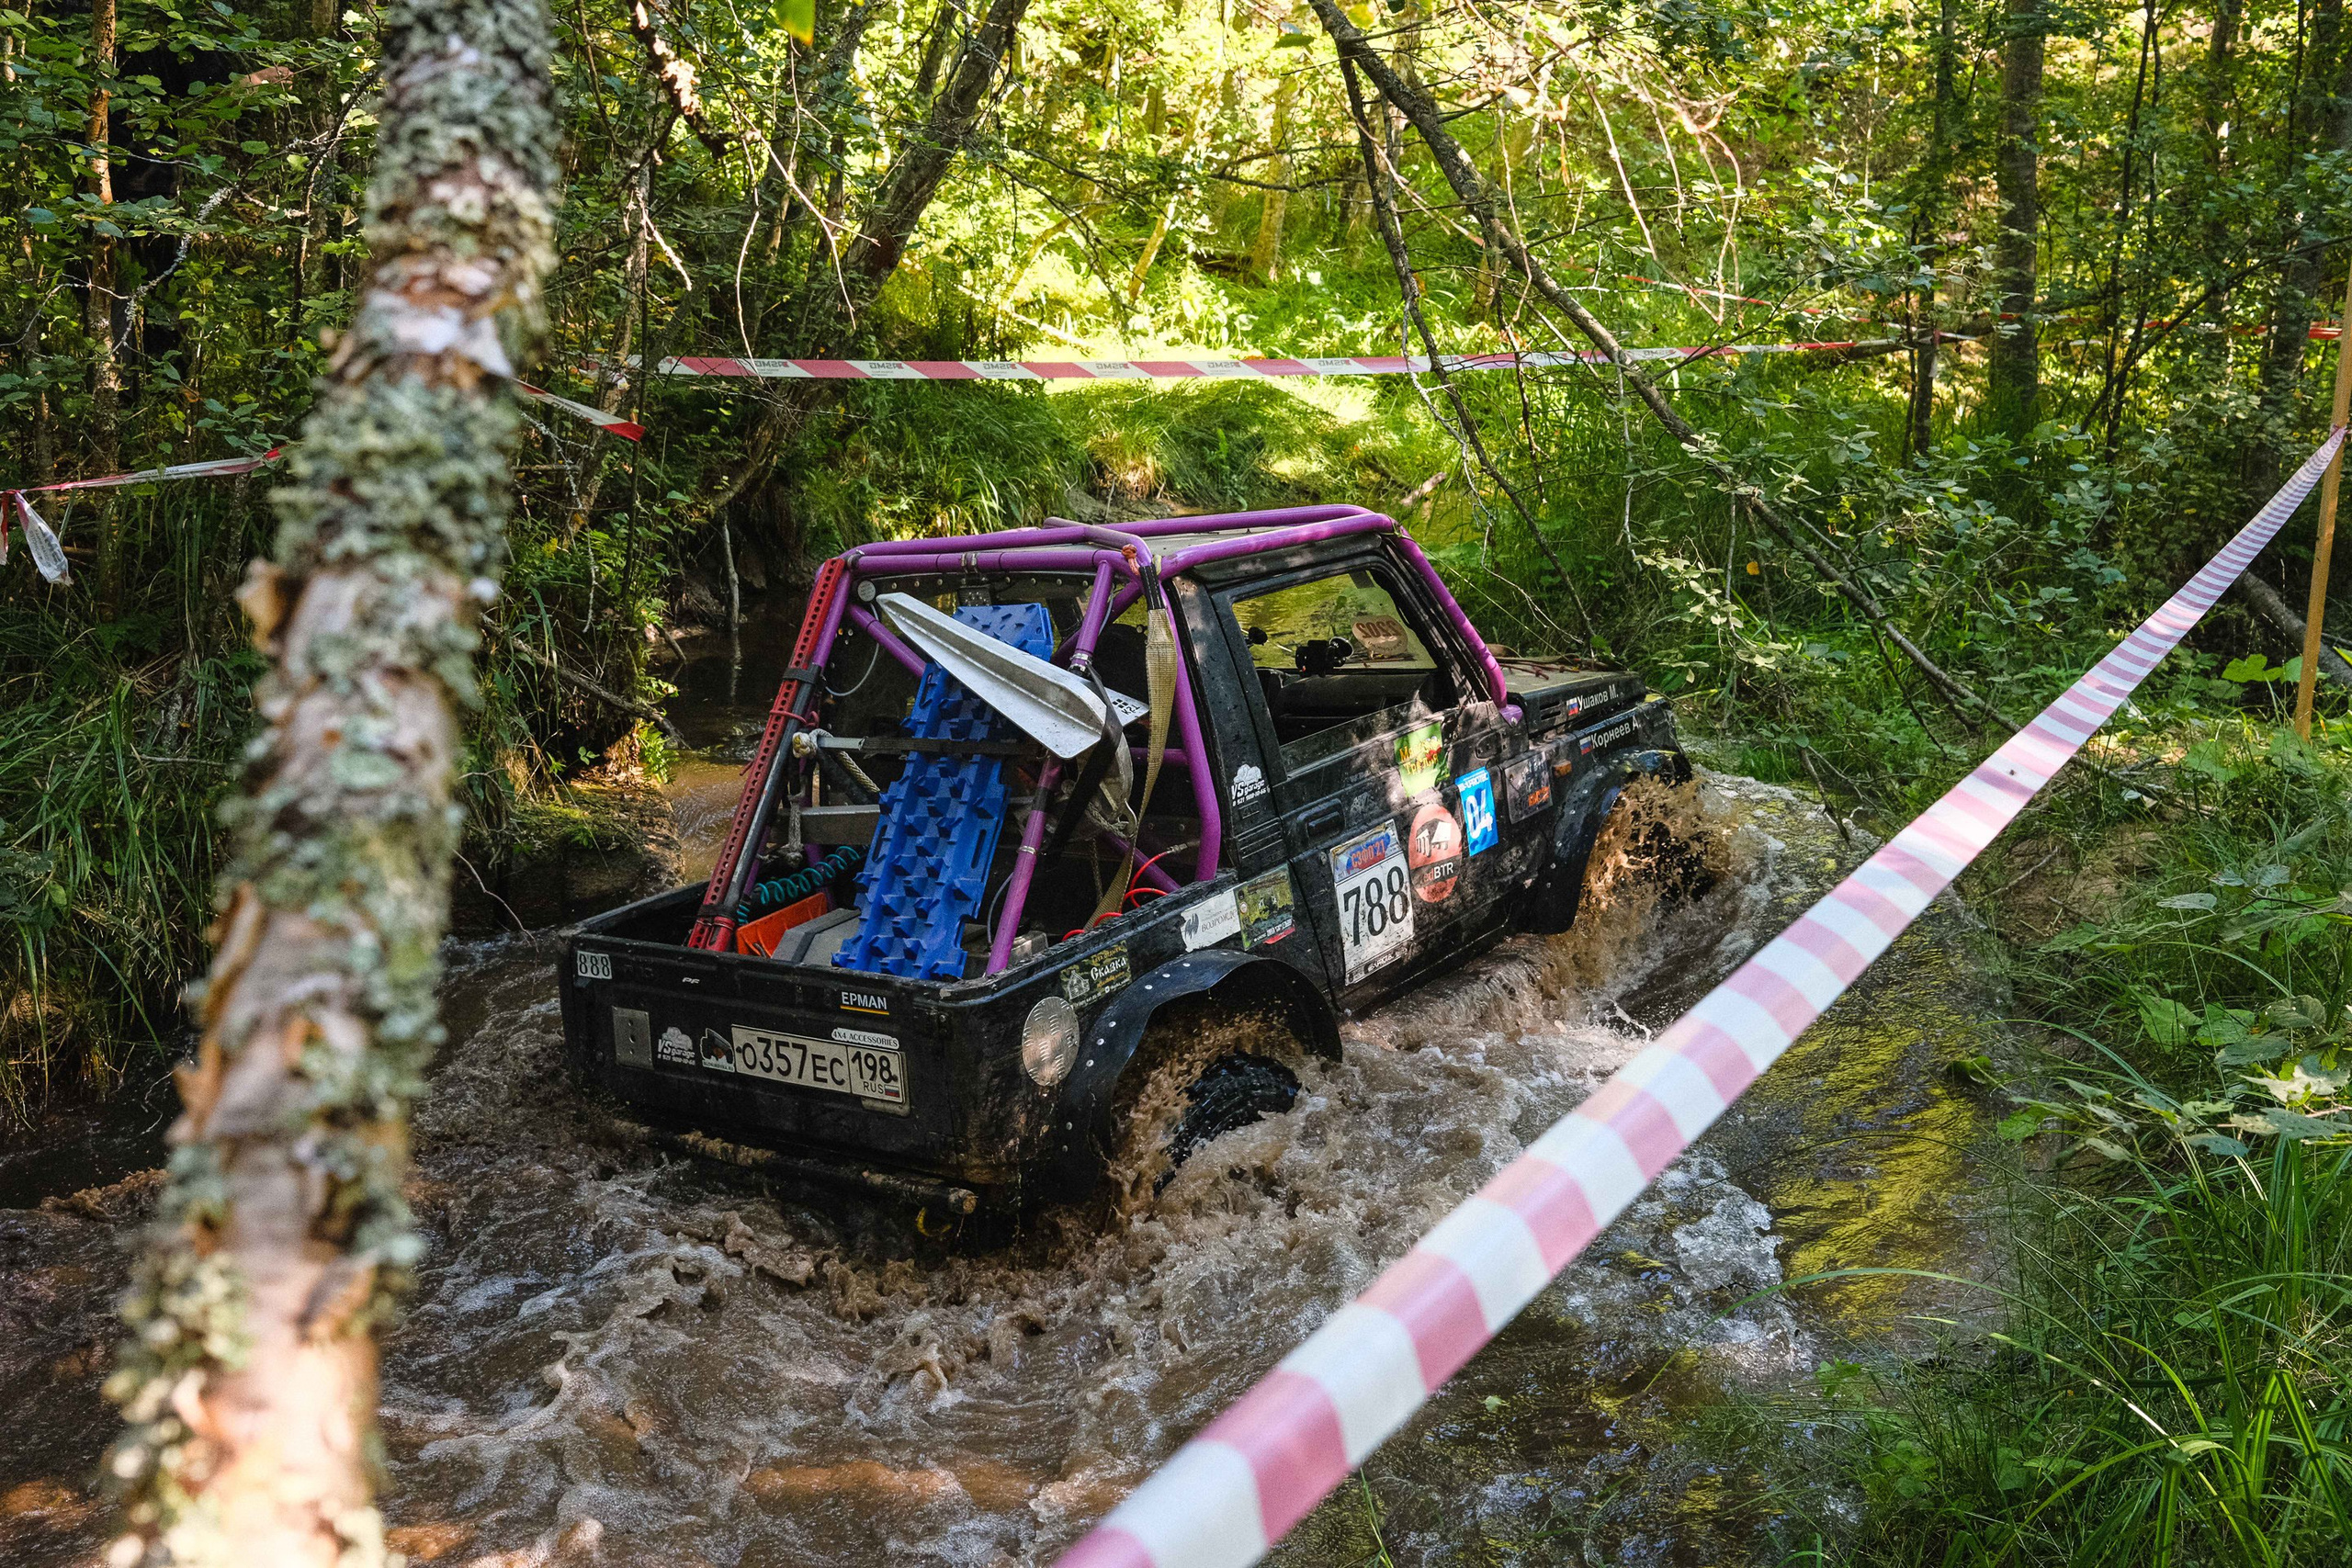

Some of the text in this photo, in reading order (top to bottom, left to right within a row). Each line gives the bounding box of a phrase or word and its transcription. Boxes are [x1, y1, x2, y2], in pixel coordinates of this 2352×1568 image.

[1577, 691, 1608, 711] Ушаков
[1591, 722, 1631, 749] Корнеев
[1343, 866, 1408, 947] 788
[579, 953, 610, 976] 888
[842, 991, 888, 1010] EPMAN
[849, 1033, 898, 1047] ACCESSORIES
[851, 1050, 893, 1084] 198
[864, 1081, 884, 1094] RUS
